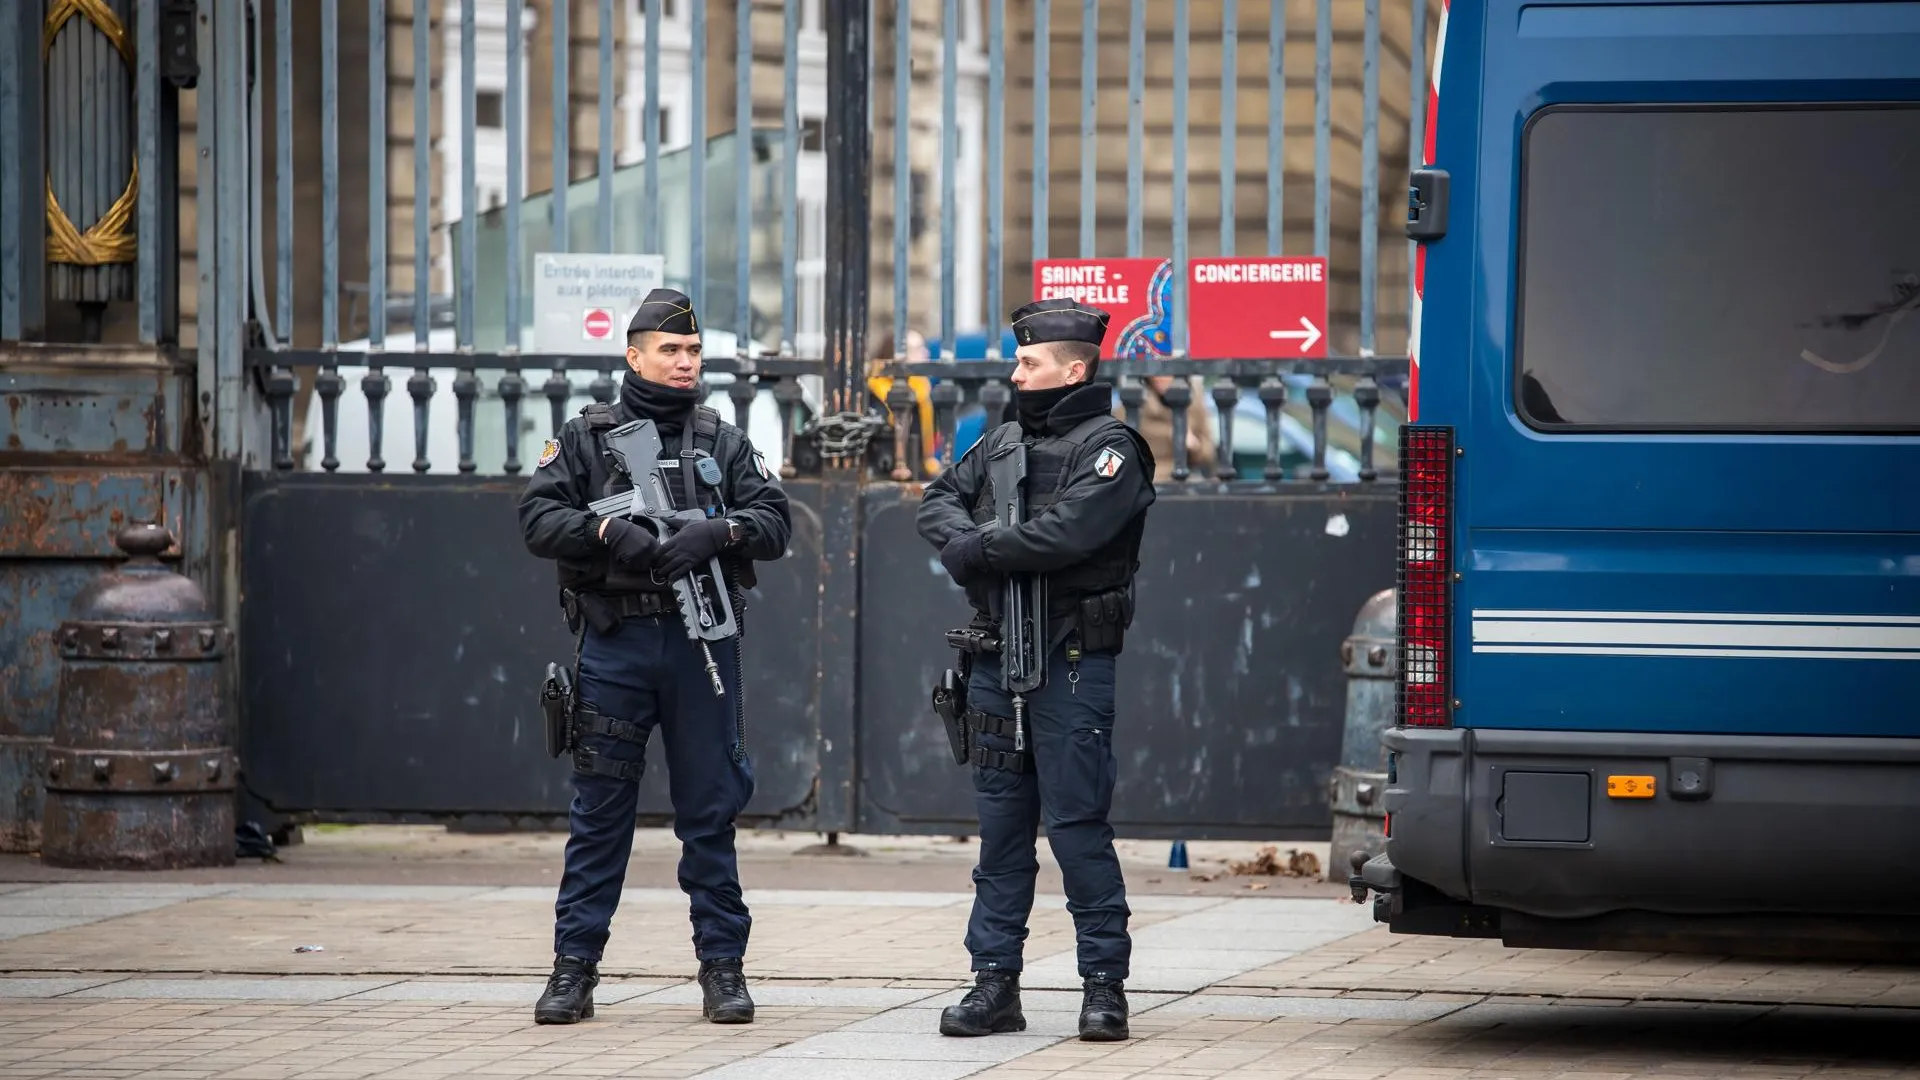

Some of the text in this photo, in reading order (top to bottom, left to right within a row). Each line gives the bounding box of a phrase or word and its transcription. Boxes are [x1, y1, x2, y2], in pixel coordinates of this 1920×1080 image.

[544, 264, 654, 280] Entrée interdite
[1041, 265, 1106, 284] SAINTE
[1195, 263, 1323, 283] CONCIERGERIE
[557, 283, 641, 301] aux piétons
[1041, 285, 1129, 304] CHAPELLE
